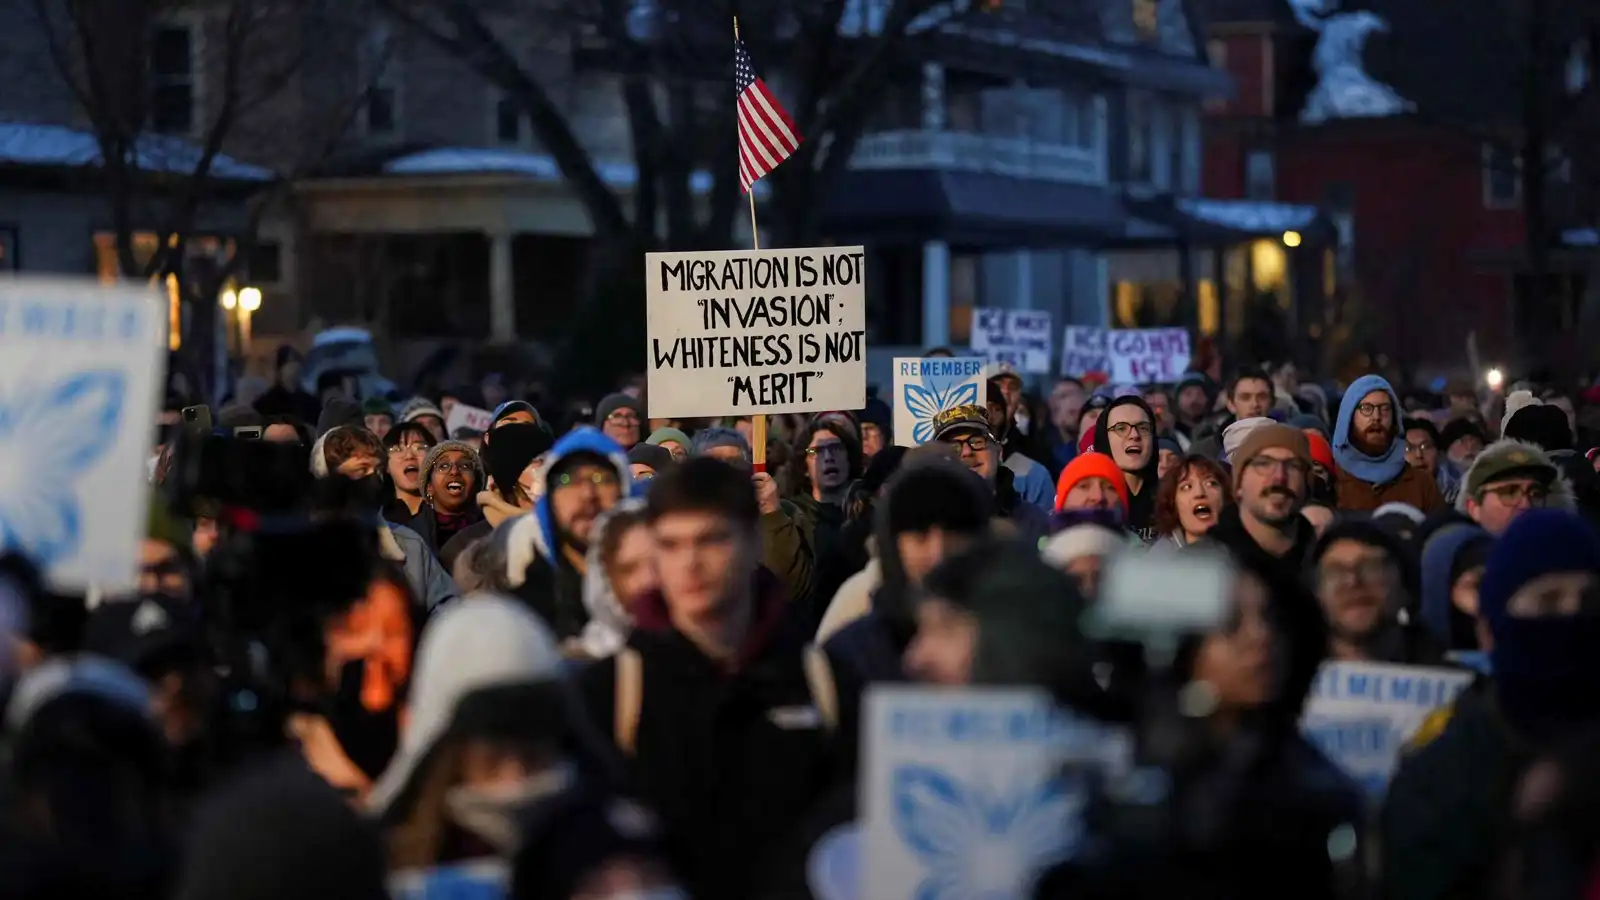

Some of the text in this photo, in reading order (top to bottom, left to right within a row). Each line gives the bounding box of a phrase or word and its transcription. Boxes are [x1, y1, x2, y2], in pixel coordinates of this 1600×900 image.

[660, 253, 864, 291] MIGRATION IS NOT
[653, 330, 864, 369] WHITENESS IS NOT
[900, 361, 981, 377] REMEMBER
